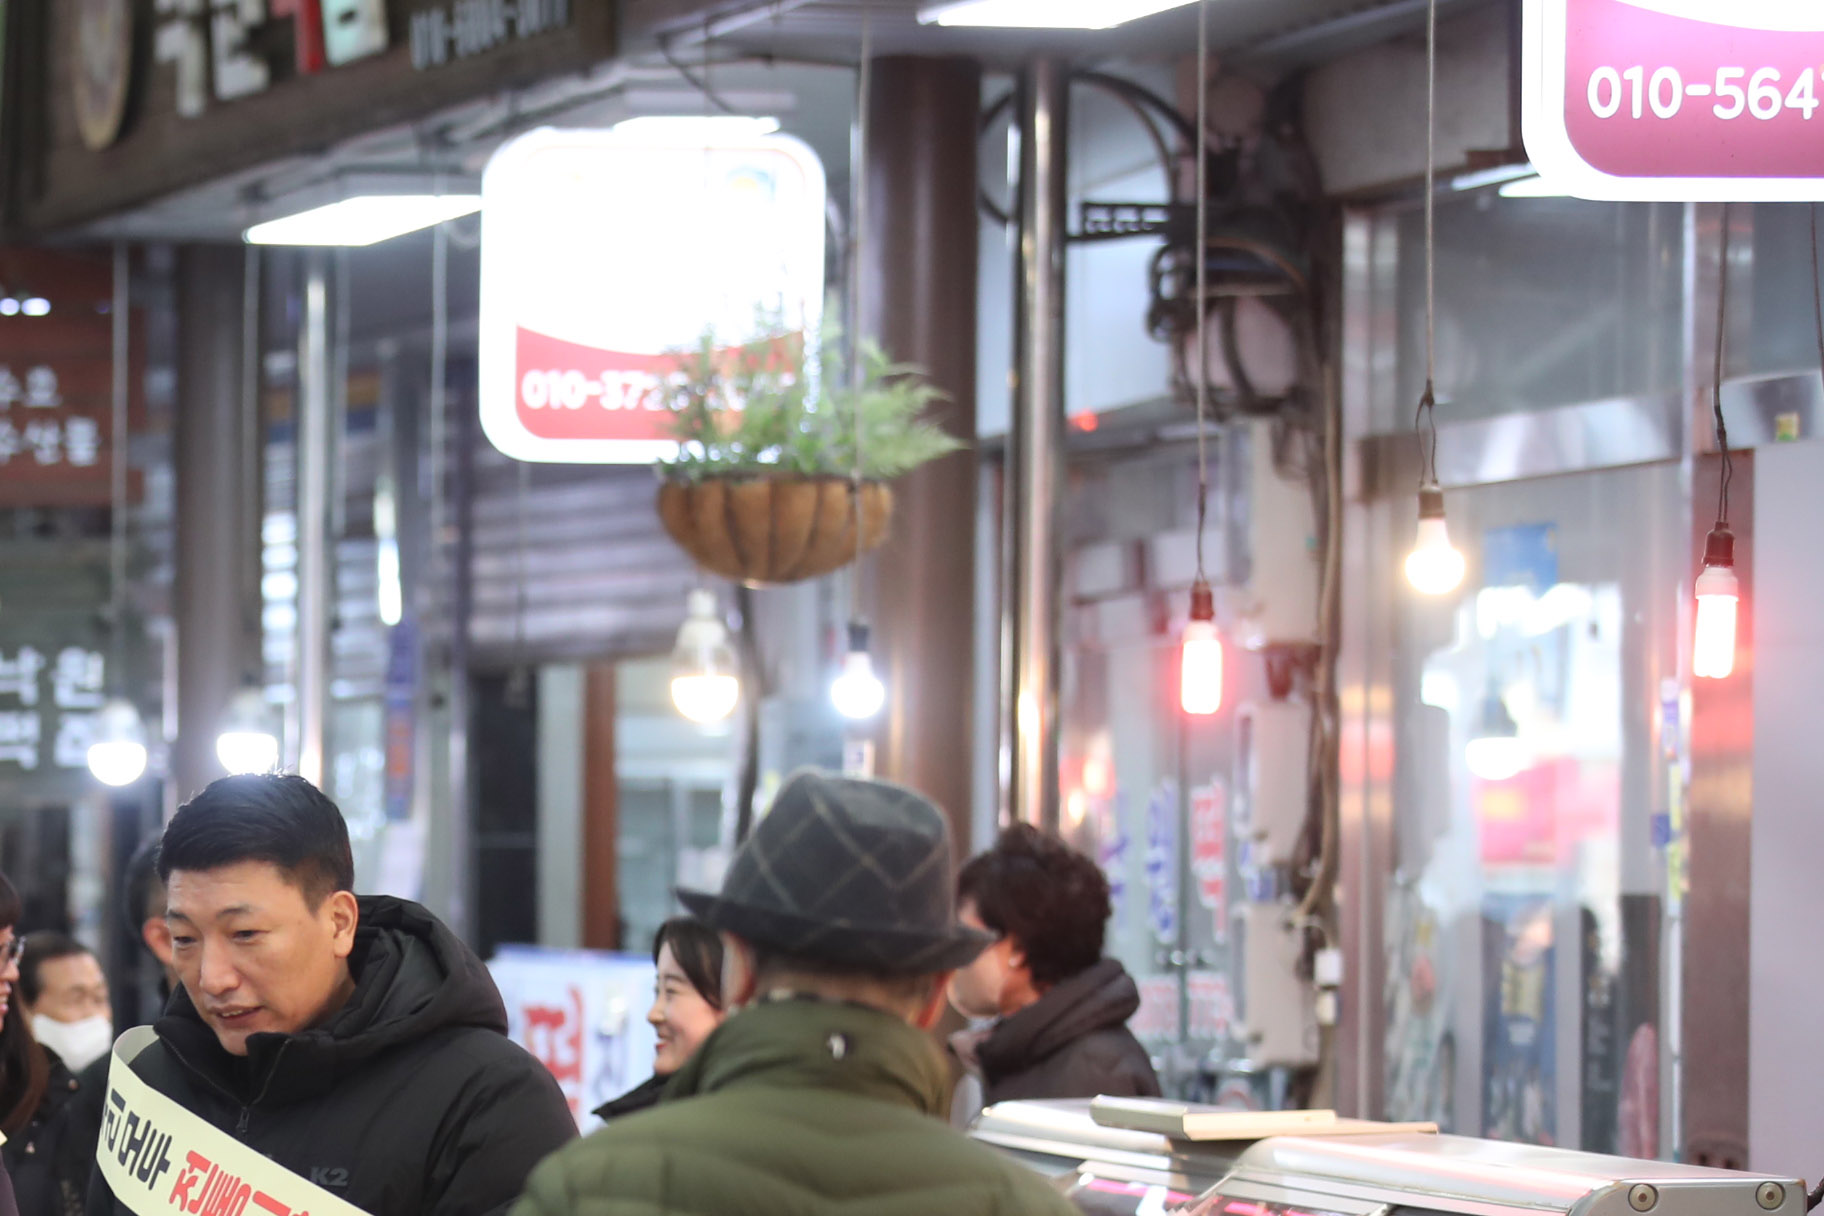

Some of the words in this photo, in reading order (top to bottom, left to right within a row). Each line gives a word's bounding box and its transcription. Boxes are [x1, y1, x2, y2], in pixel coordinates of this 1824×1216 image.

[1587, 65, 1824, 121] 010-564
[100, 1087, 126, 1153] 리
[117, 1110, 173, 1191] 모두
[310, 1166, 350, 1187] K2
